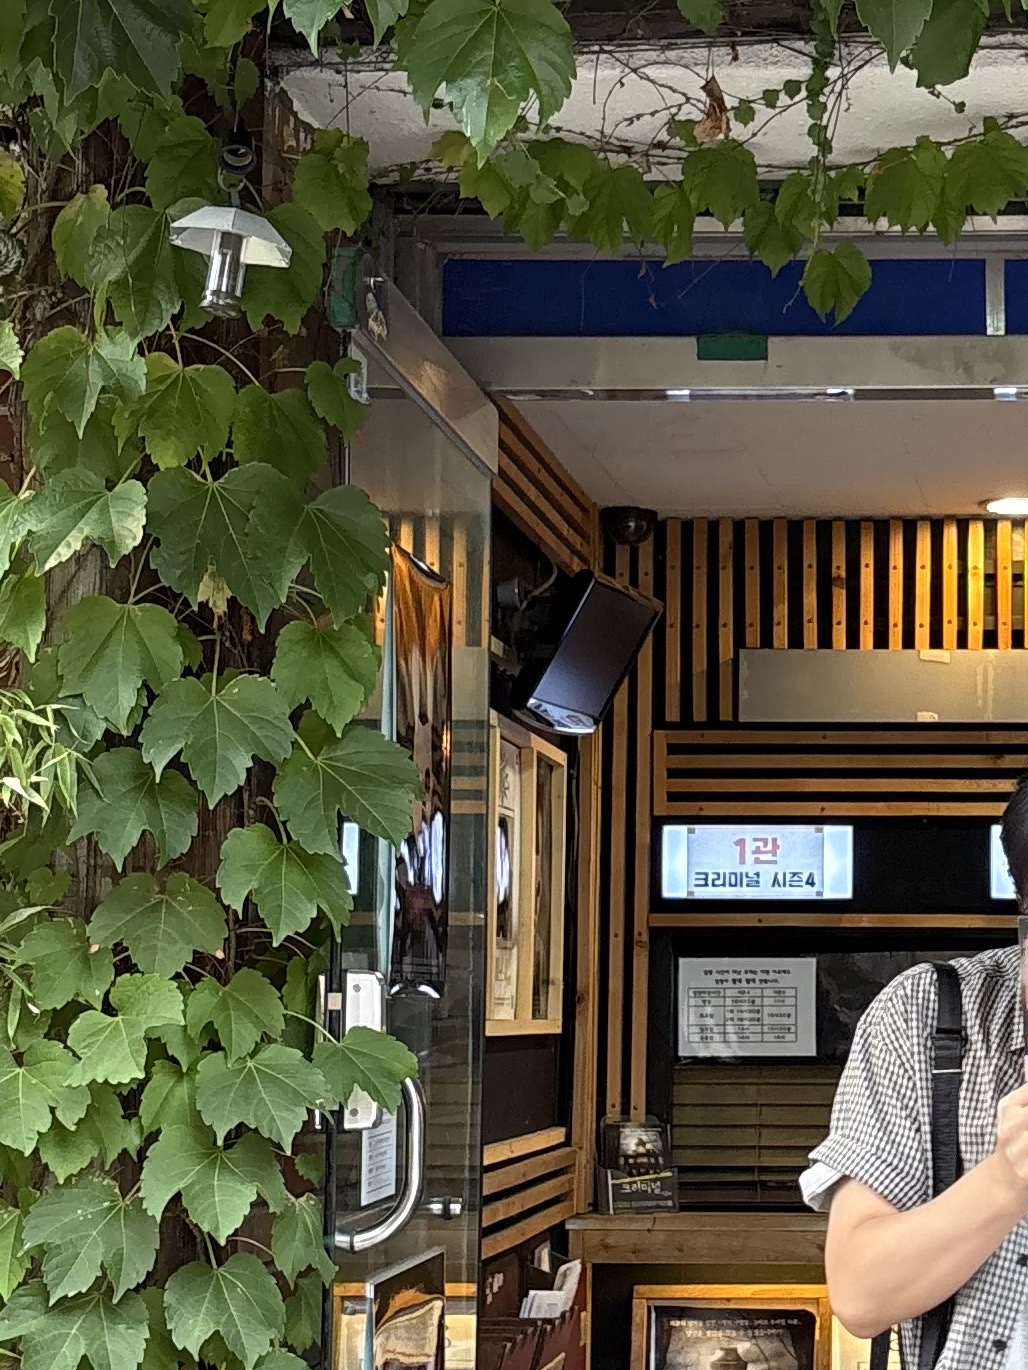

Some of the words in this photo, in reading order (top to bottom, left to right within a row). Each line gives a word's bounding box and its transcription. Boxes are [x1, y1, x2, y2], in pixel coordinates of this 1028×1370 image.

[733, 836, 780, 865] 1관
[694, 871, 760, 888] 크리미널
[771, 871, 816, 888] 시즌4
